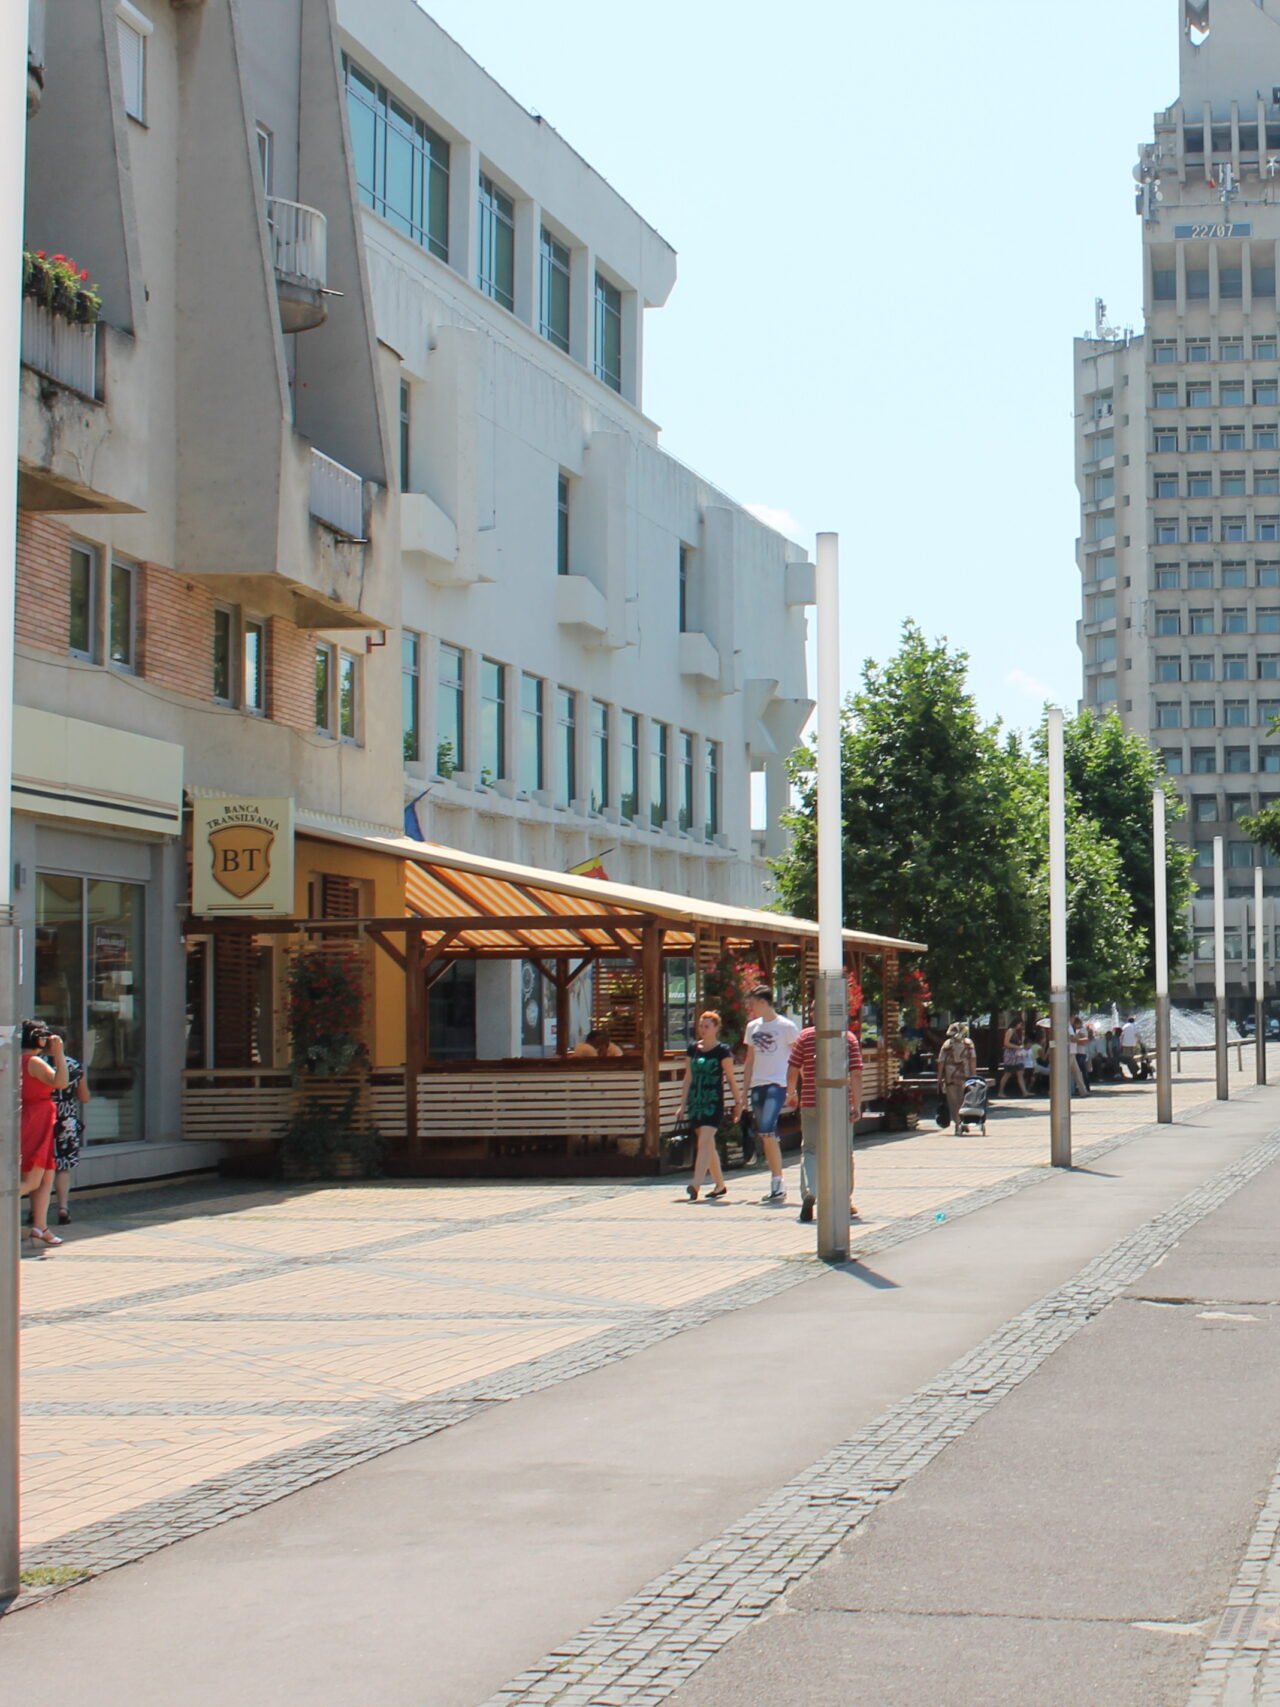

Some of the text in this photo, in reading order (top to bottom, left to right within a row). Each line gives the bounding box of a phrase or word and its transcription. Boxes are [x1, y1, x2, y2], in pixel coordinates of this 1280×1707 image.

[1191, 224, 1234, 239] 22/07
[224, 805, 259, 814] BANCA
[207, 815, 279, 830] TRANSILVANIA
[222, 849, 261, 872] BT
